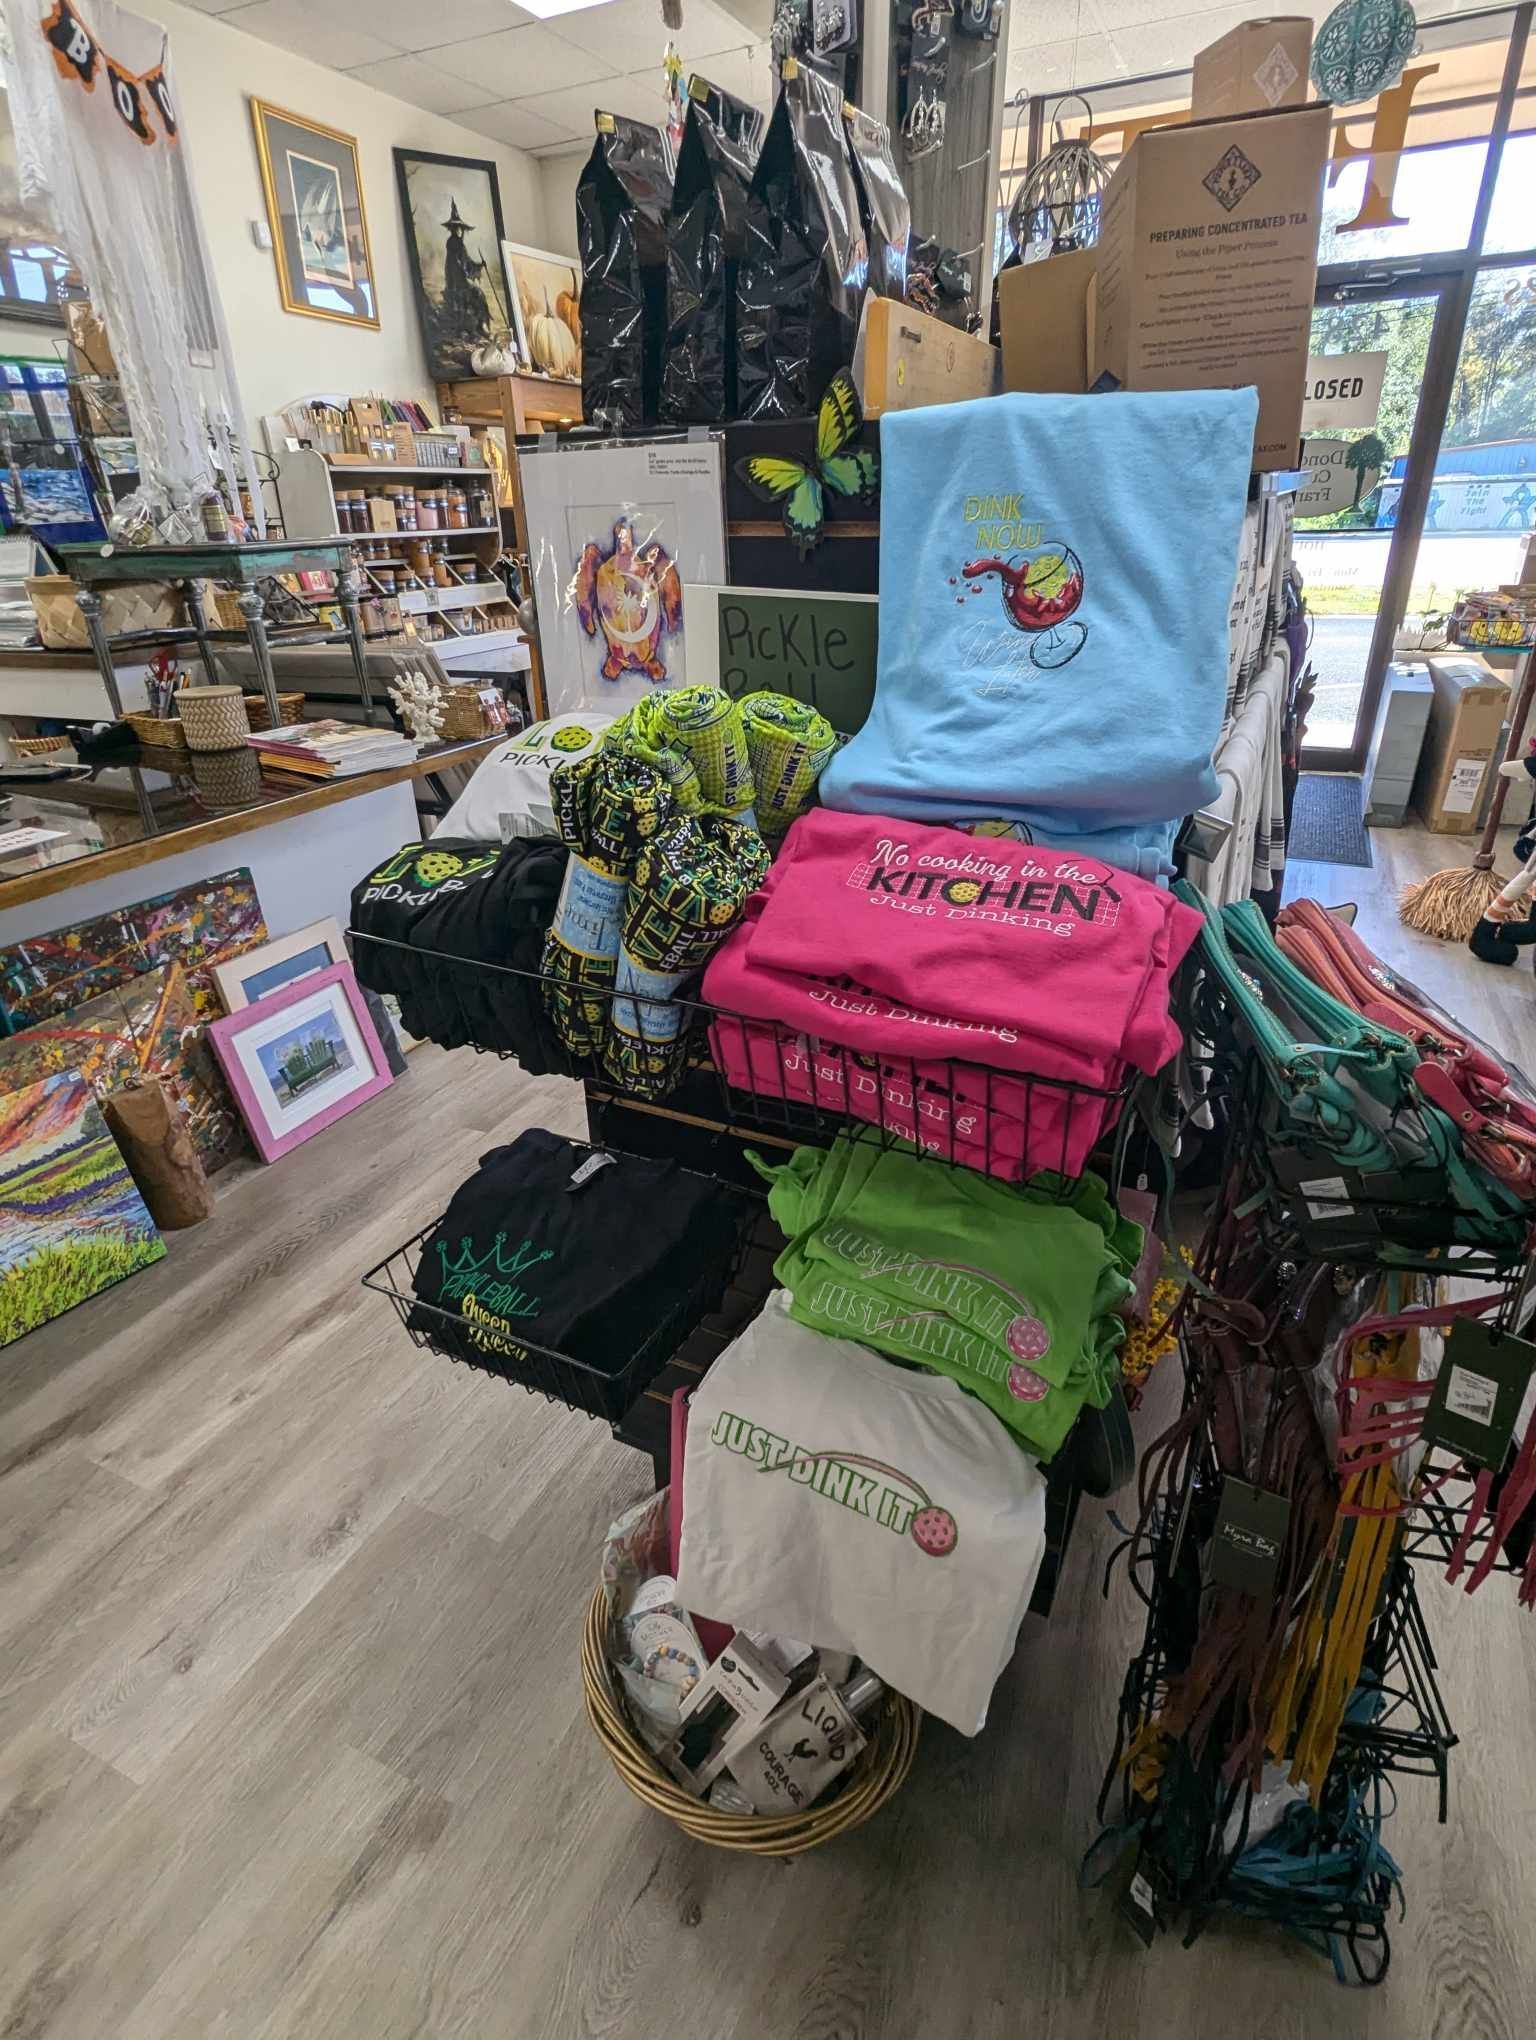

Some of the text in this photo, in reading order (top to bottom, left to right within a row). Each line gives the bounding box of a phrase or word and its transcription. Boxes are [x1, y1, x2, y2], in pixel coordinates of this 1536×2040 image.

[1150, 212, 1308, 243] PREPARING CONCENTRATED TEA
[1304, 377, 1364, 400] LOSED
[964, 495, 1022, 521] DINK
[976, 523, 1041, 550] NOW
[870, 839, 1098, 885] No cooking in the
[866, 866, 1100, 921] KITCHEN
[870, 894, 1076, 938] Just Dinking
[808, 990, 878, 1017] Just
[823, 1228, 1018, 1340] JUST DINK IT
[810, 1281, 890, 1334] JUST
[887, 1306, 976, 1367] DINK
[711, 1411, 918, 1535] JUST DINK IT
[758, 1741, 805, 1806] COURAGE
